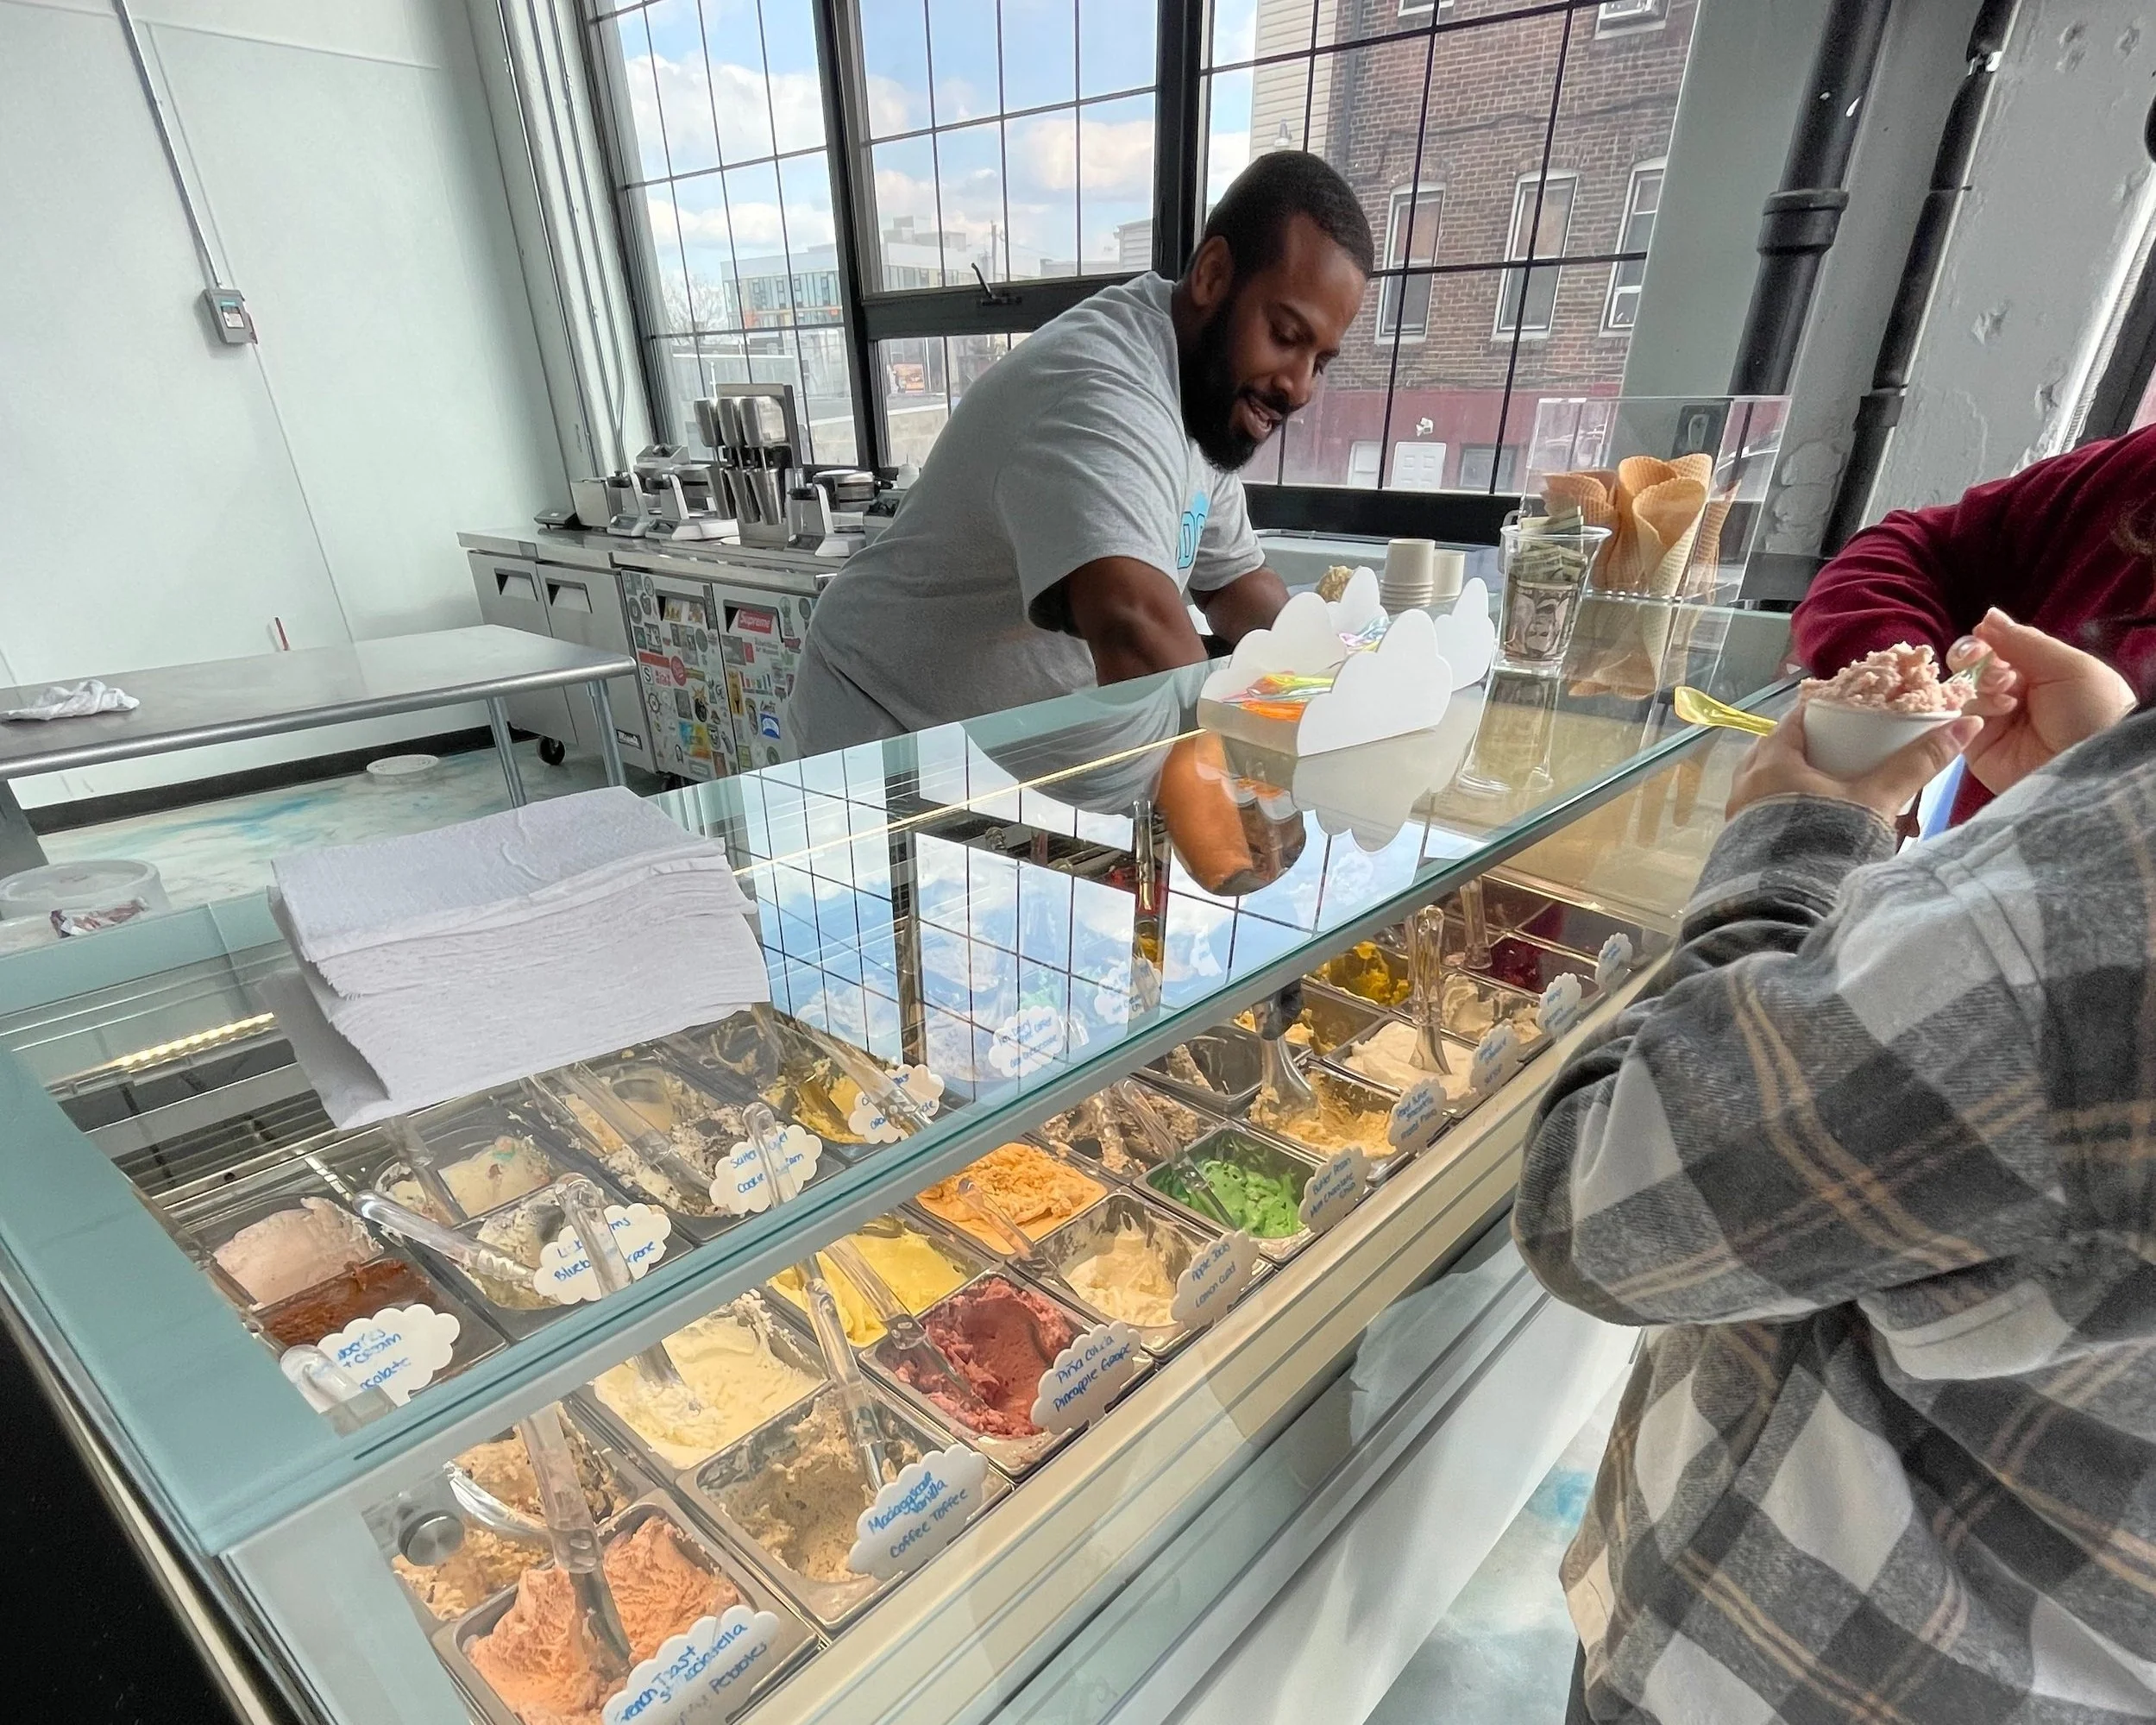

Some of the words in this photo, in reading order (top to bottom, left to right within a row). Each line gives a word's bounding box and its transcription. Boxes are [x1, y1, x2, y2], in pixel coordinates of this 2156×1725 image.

[1053, 1368, 1098, 1413] Pineapple
[1055, 1357, 1084, 1384] Piña
[889, 1520, 931, 1558] Coffee
[929, 1488, 968, 1521] Toffee
[651, 1645, 696, 1690] Tast
